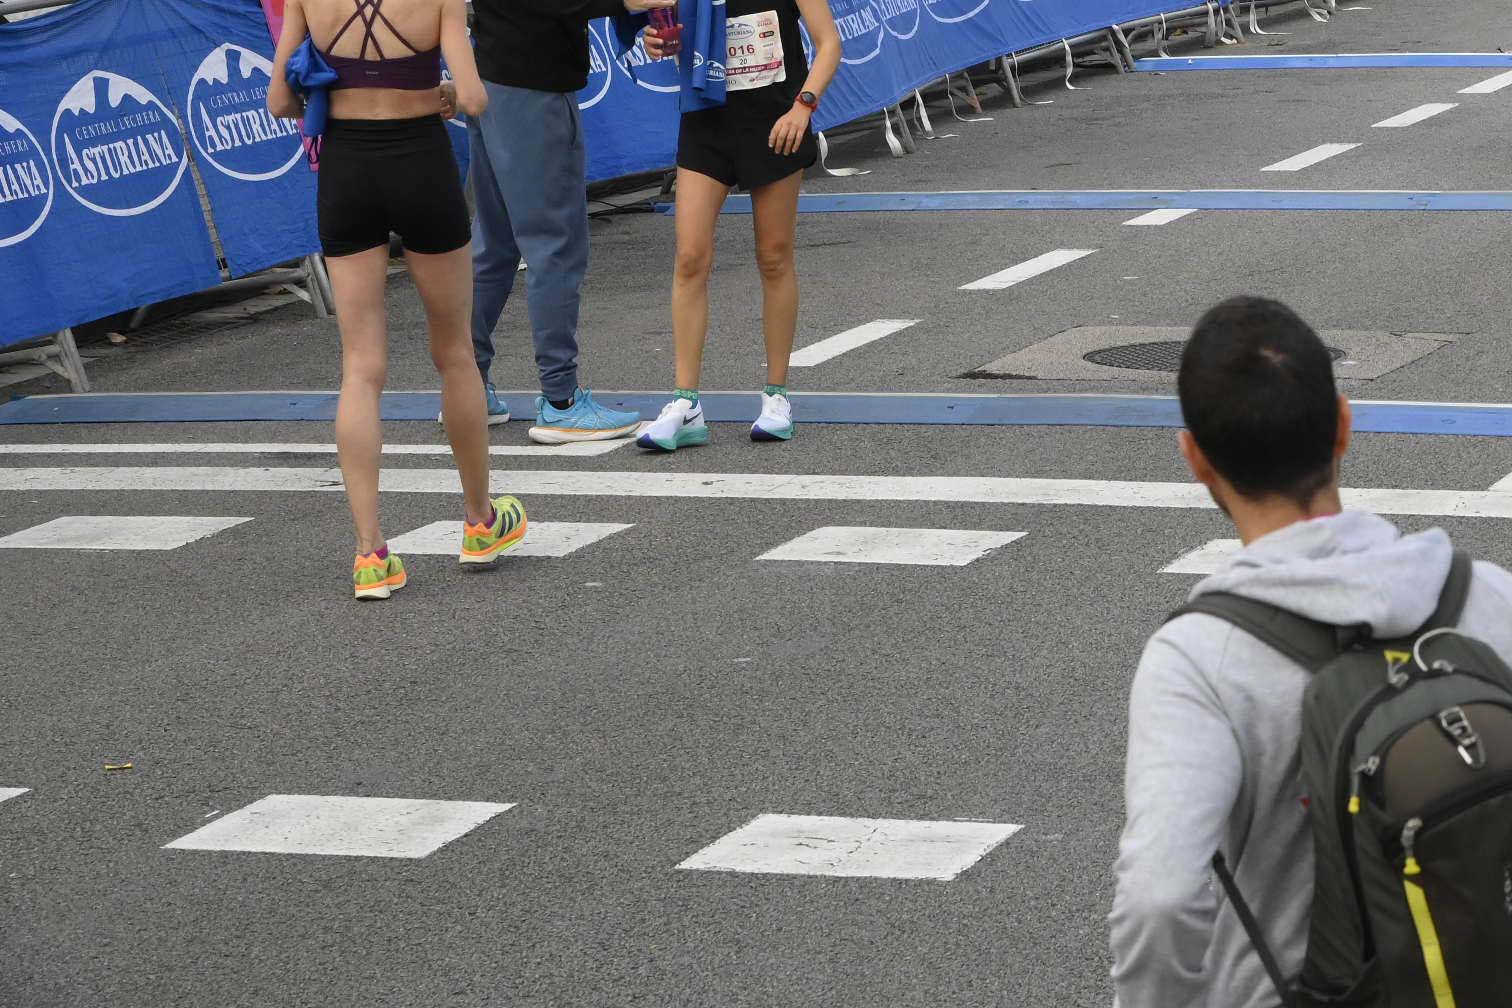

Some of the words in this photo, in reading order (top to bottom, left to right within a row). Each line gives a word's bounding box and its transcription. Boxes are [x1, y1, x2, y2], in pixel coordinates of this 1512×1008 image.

[740, 58, 748, 66] 20
[211, 91, 250, 109] CENTRAL
[75, 119, 118, 141] CENTRAL
[119, 109, 161, 130] LECHERA
[64, 129, 179, 188] ASTURIANA
